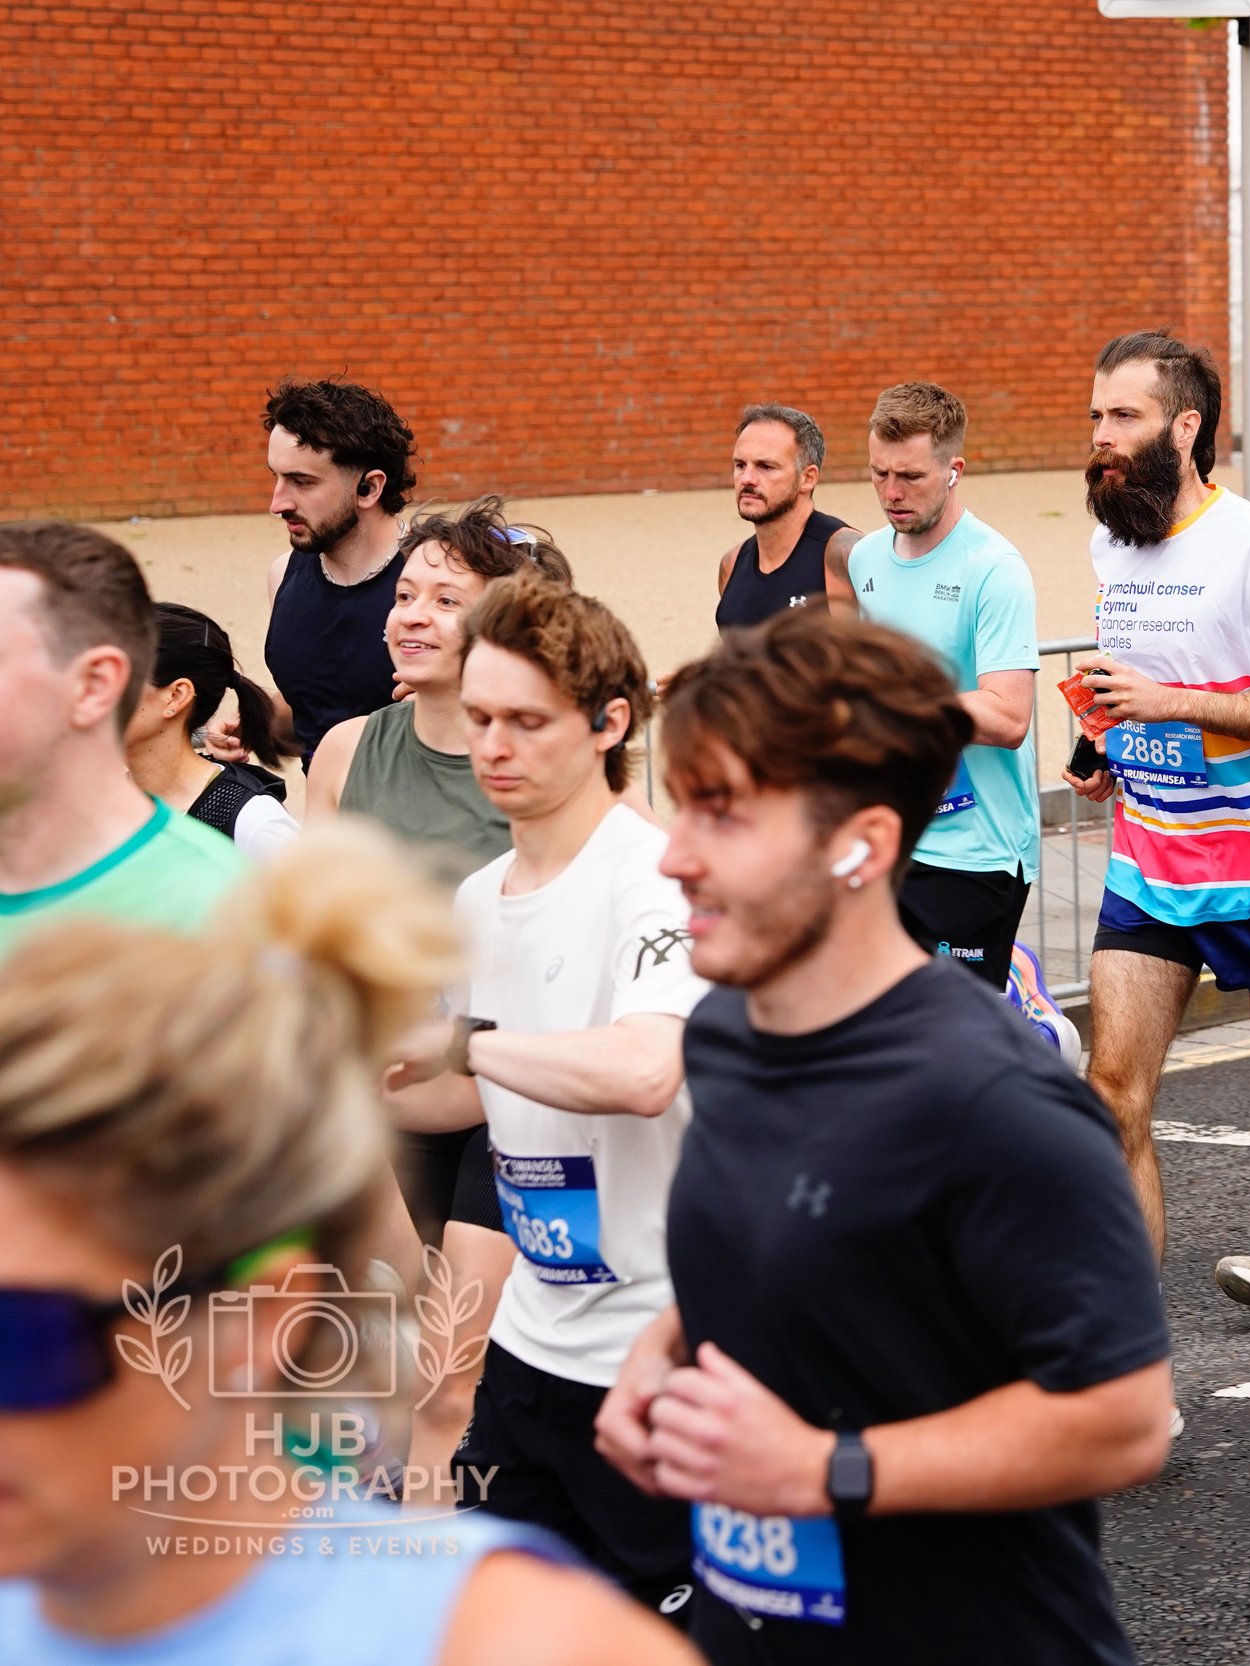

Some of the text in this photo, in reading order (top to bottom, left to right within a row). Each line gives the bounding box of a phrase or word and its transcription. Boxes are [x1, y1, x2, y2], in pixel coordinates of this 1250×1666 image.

[936, 583, 951, 592] BMW
[1107, 581, 1205, 596] ymchwil canser
[1103, 600, 1138, 614] cymru
[1101, 618, 1195, 632] cancer research
[1101, 635, 1132, 649] wales
[1121, 733, 1183, 767] 2885
[1123, 768, 1186, 785] #RUNSWANSEA
[511, 1160, 563, 1172] SWANSEA
